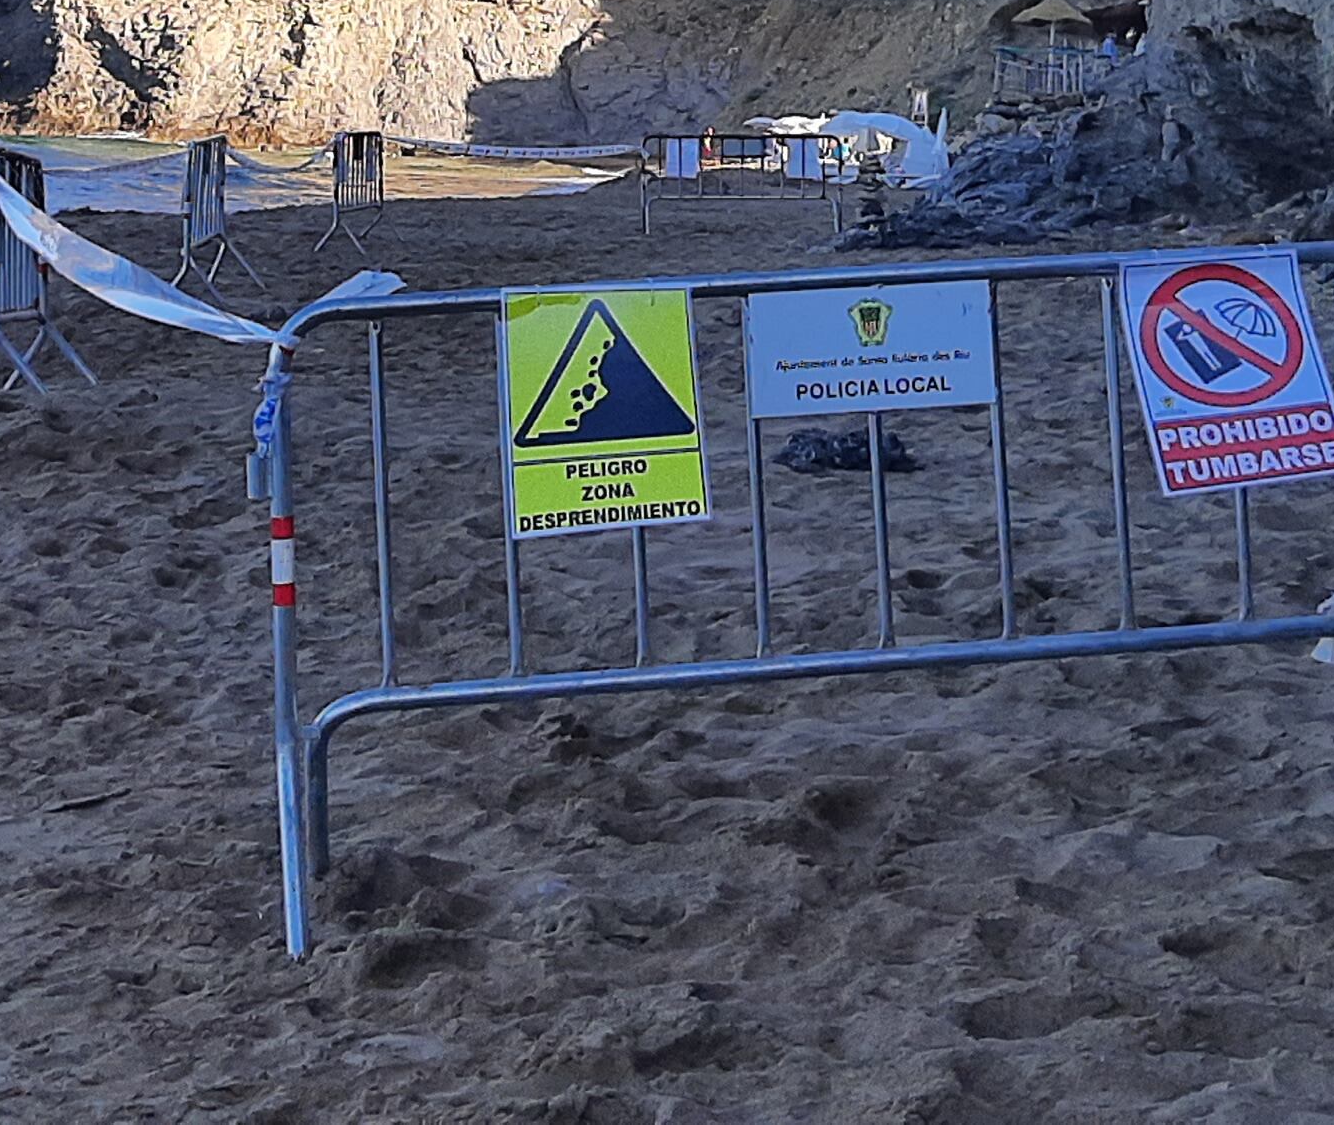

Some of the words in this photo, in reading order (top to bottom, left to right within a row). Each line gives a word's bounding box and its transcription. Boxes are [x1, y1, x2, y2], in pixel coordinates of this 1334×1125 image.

[841, 356, 855, 367] de
[796, 379, 880, 400] POLICIA
[884, 376, 952, 395] LOCAL
[1157, 410, 1334, 452] PROHIBIDO
[565, 459, 648, 479] PELIGRO
[581, 482, 636, 502] ZONA
[519, 500, 702, 532] DESPRENDIMIENTO
